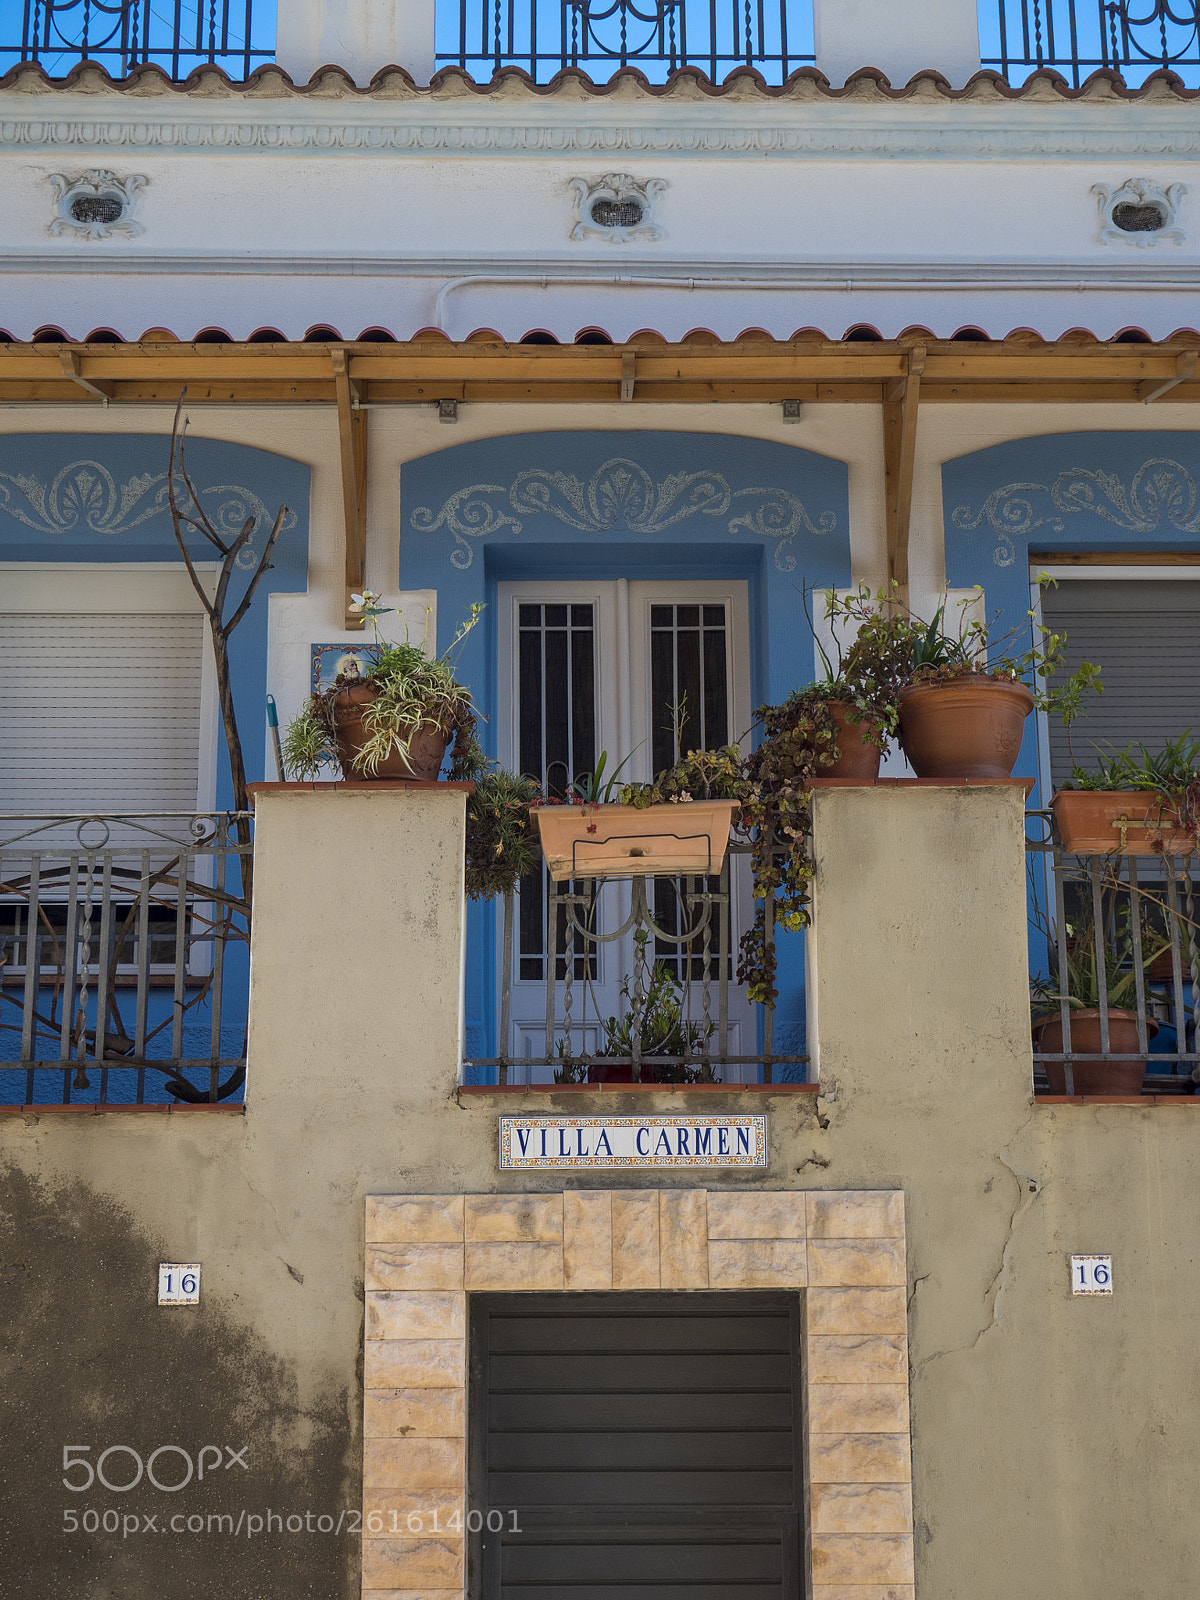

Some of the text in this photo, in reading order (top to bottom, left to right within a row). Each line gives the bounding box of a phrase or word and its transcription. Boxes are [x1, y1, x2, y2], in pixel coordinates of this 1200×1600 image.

[516, 1127, 750, 1157] VILLA CARMEN
[164, 1273, 197, 1294] 16
[1076, 1264, 1109, 1285] 16
